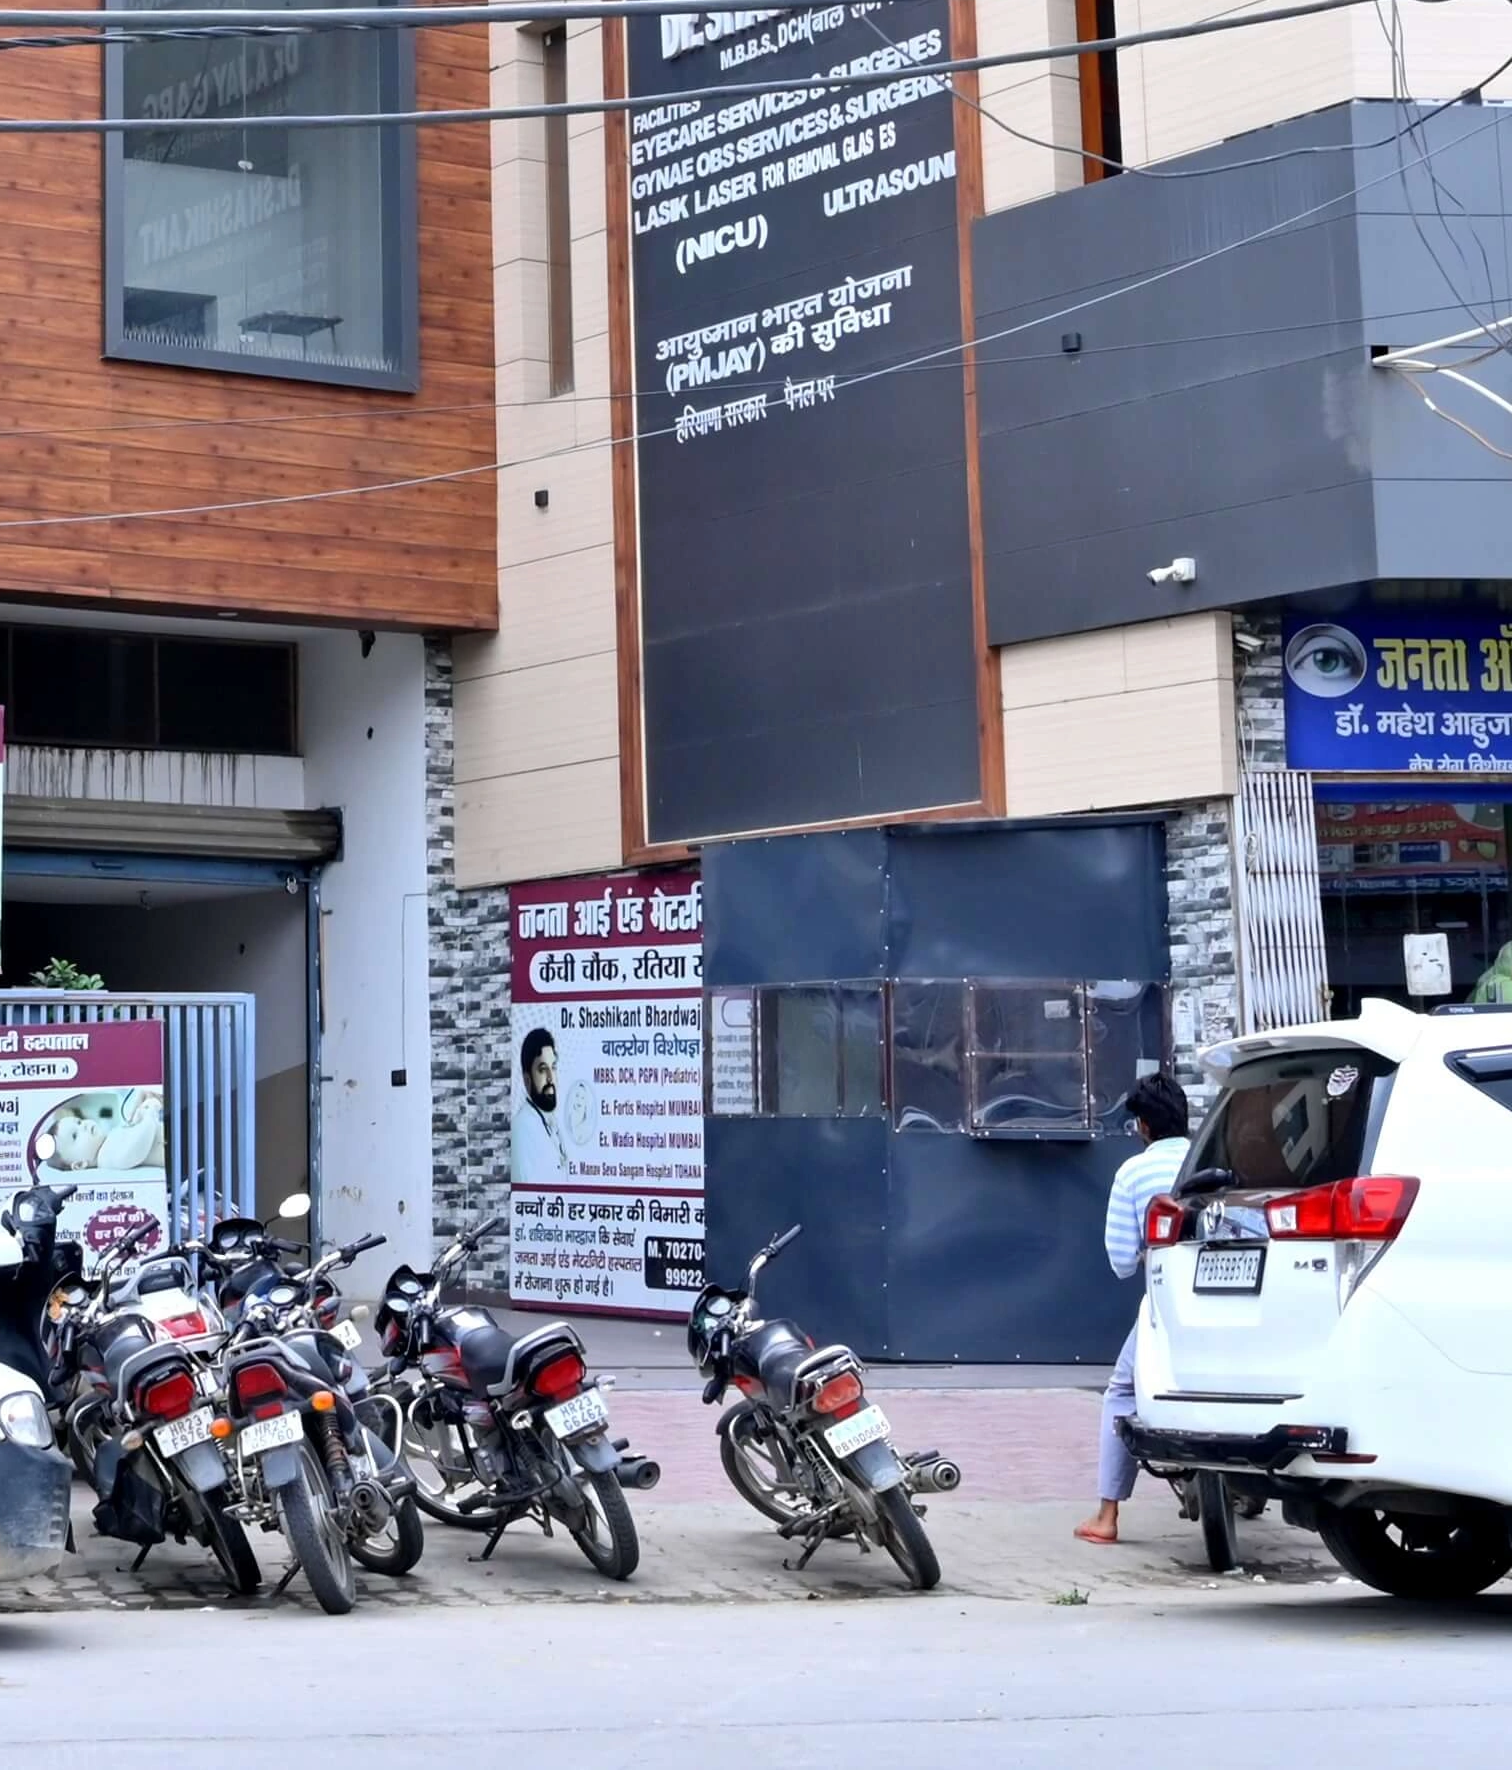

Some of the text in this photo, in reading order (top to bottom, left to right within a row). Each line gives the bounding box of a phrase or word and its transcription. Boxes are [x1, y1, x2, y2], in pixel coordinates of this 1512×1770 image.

[632, 114, 716, 166] EYECARE
[632, 158, 696, 200] GYNAE
[696, 142, 736, 177] OBS
[735, 115, 830, 163] SERVICES
[828, 107, 845, 130] &
[634, 194, 689, 235] LASIK
[694, 172, 758, 215] LASER
[762, 160, 785, 192] FOR
[787, 139, 841, 186] REMOVAL
[656, 263, 914, 363] आयुष्मान भारत योजना
[666, 300, 893, 396] (PMJAY) की सुविधा
[816, 373, 837, 407] पर
[1373, 637, 1472, 692] जनता
[1334, 702, 1369, 737] डॉ.
[1376, 702, 1435, 739] महेश
[561, 1002, 702, 1031] Dr. Shashikant Bhardwaj
[514, 1195, 692, 1224] बच्चों की हर प्रकार की बिमारी
[167, 1414, 203, 1437] HR23
[560, 1395, 593, 1418] HR23
